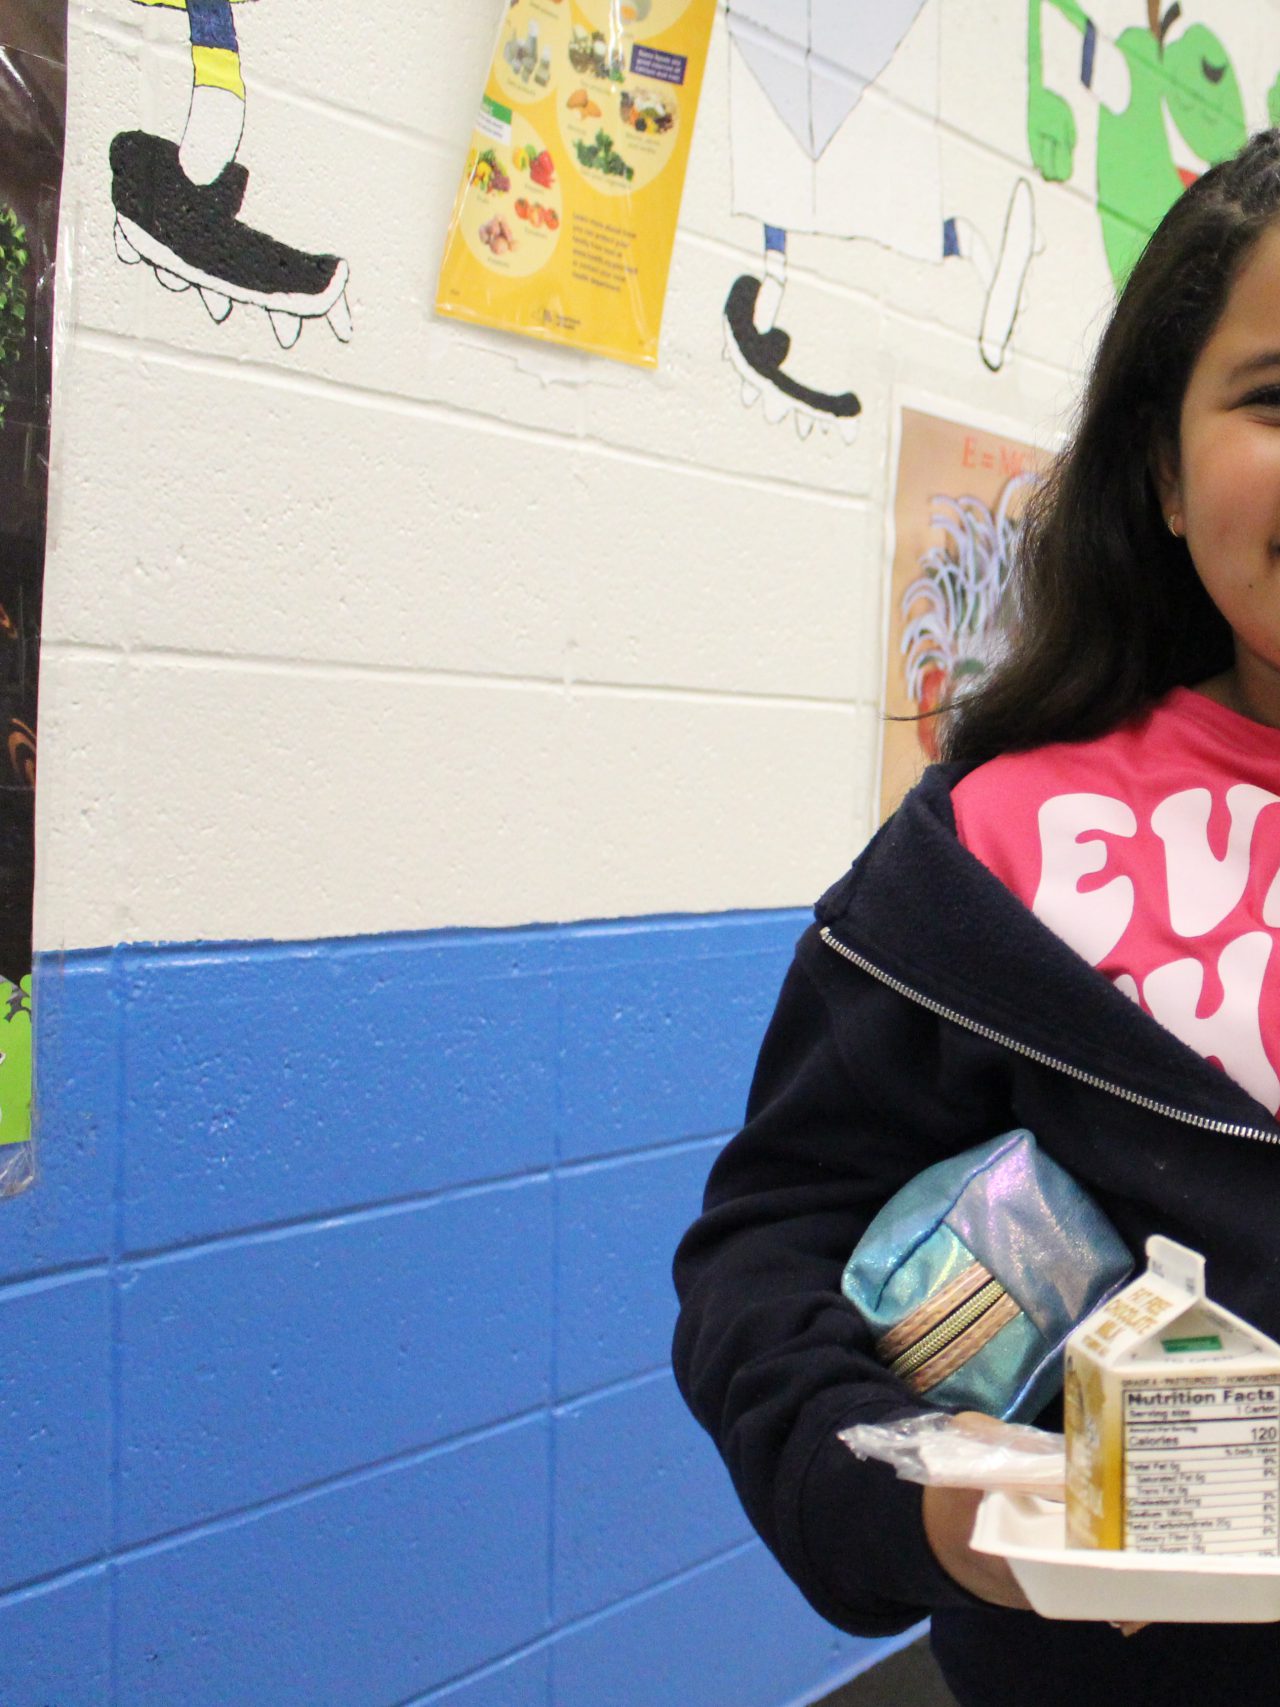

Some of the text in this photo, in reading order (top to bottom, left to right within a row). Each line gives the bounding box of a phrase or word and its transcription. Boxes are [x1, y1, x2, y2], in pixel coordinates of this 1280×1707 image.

[1128, 1388, 1275, 1406] Nutrition Facts
[1129, 1426, 1278, 1447] Calories 120
